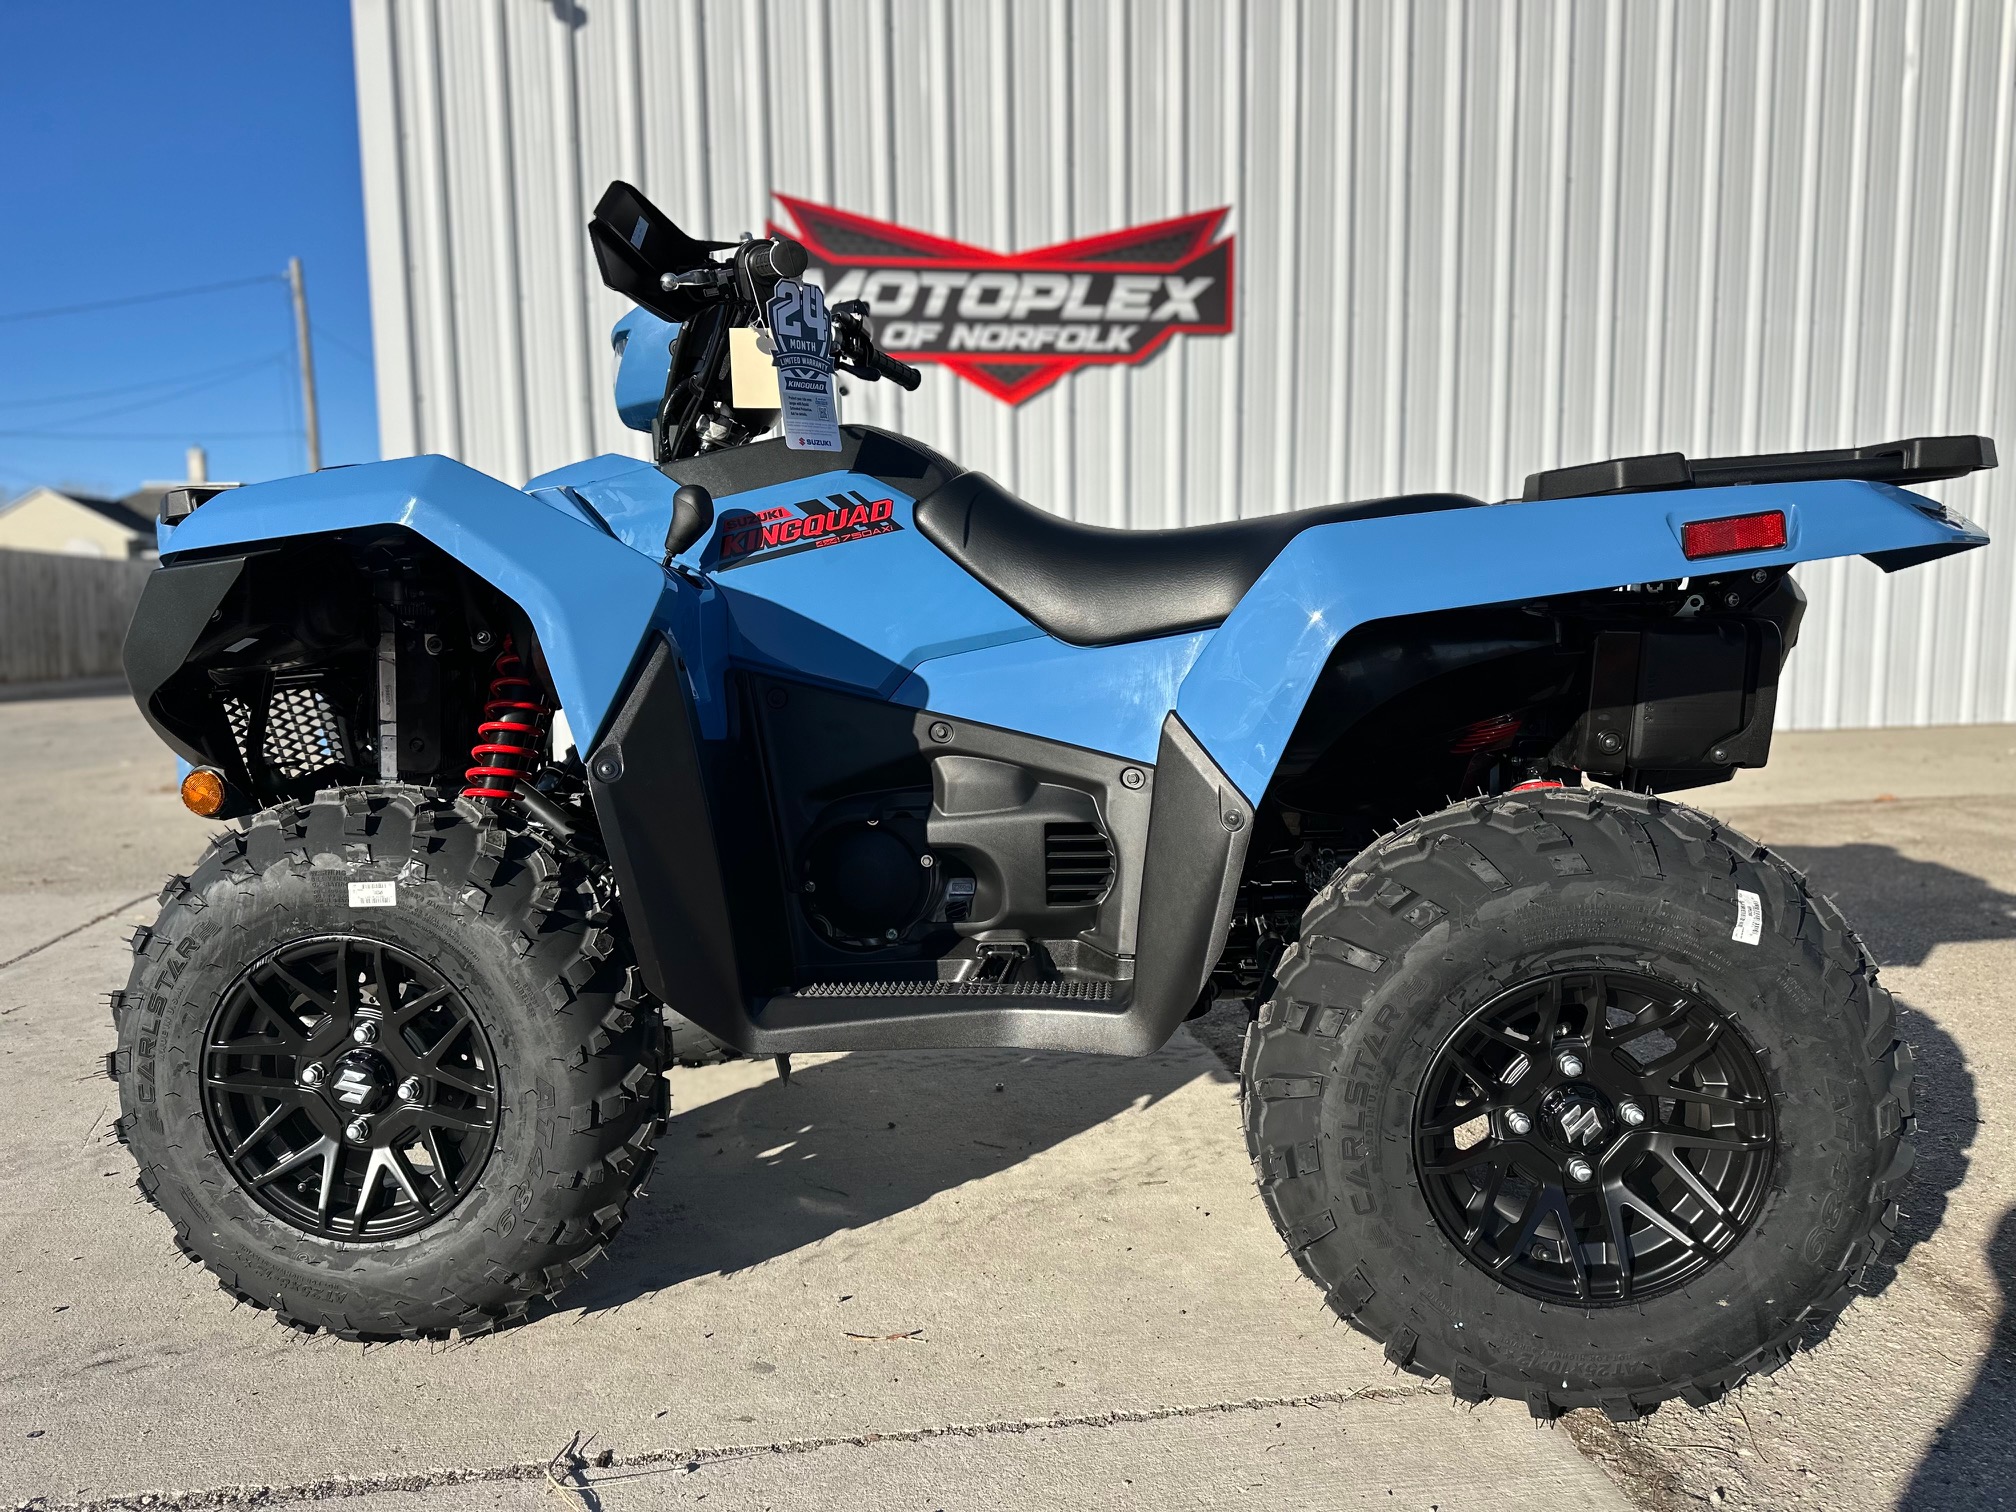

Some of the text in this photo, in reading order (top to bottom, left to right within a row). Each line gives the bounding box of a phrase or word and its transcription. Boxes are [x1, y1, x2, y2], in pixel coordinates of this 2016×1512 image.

[776, 280, 827, 341] 24
[806, 268, 1214, 323] MOTOPLEX
[790, 338, 816, 352] MONTH
[879, 321, 1140, 353] OF NORFOLK
[780, 356, 828, 372] LIMITED WARRANTY
[788, 380, 825, 391] KINGQUAD
[806, 438, 832, 447] SUZUKI
[721, 498, 893, 560] KINGQUAD
[726, 508, 785, 530] SUZUKI
[138, 934, 201, 1104] CARLSTAR
[1341, 1002, 1405, 1216] CARLSTAR
